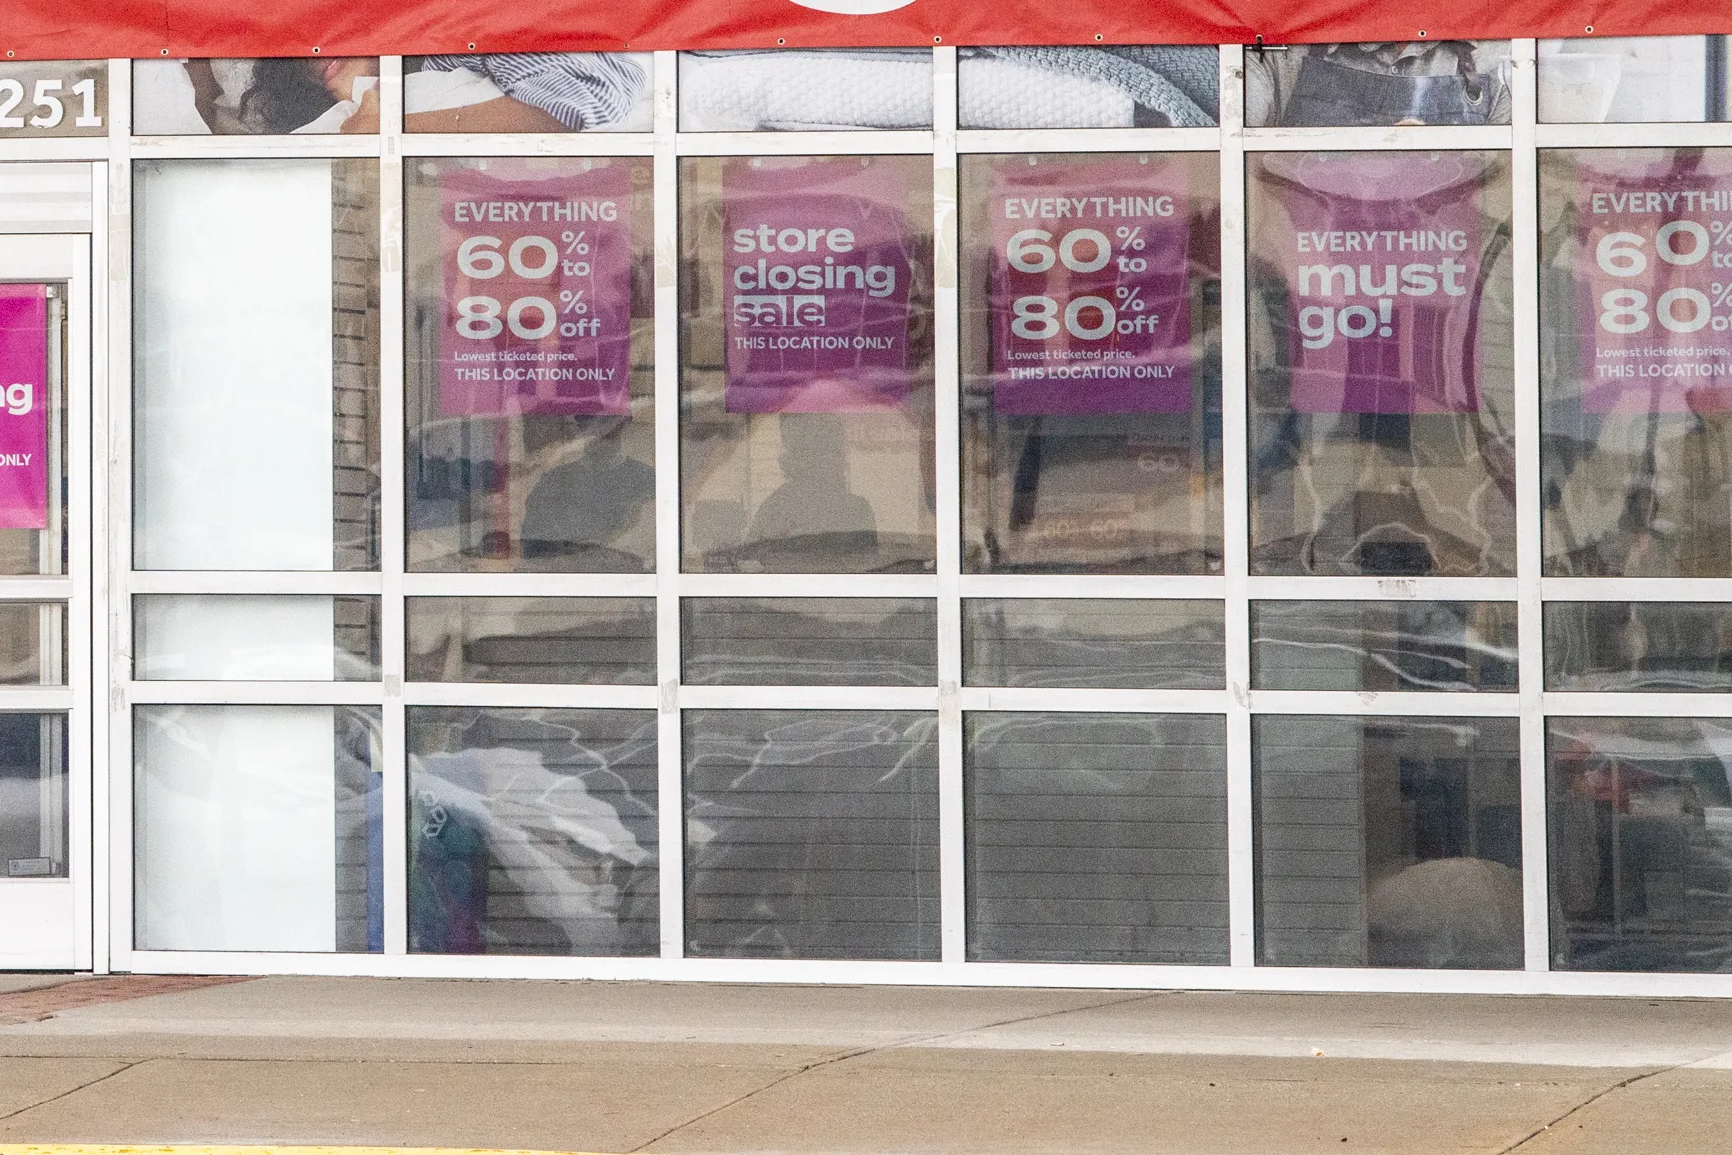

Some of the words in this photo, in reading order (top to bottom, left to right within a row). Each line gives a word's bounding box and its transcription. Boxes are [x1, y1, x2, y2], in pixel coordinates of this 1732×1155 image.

[454, 201, 617, 223] EVERYTHING
[1005, 196, 1175, 219] EVERYTHING
[1592, 191, 1732, 214] EVERYTHI
[733, 224, 855, 253] store
[1297, 230, 1468, 254] EVERYTHING
[562, 258, 590, 278] to
[1117, 255, 1147, 274] to
[733, 257, 896, 298] closing
[1298, 257, 1466, 296] must
[733, 295, 826, 327] sale
[559, 318, 601, 338] off
[1117, 315, 1159, 335] off
[1298, 298, 1393, 350] go!
[735, 336, 767, 350] THIS
[769, 336, 851, 350] LOCATION
[853, 335, 895, 349] ONLY
[1596, 347, 1641, 358] Lowest
[1642, 346, 1693, 357] ticketed
[454, 350, 496, 362] Lowest
[498, 350, 544, 362] ticketed
[546, 351, 578, 364] price.
[1007, 349, 1051, 361] Lowest
[1053, 348, 1102, 360] ticketed
[1103, 348, 1136, 363] price.
[454, 368, 490, 382] THIS
[494, 368, 573, 381] LOCATION
[576, 367, 616, 381] ONLY
[1008, 367, 1045, 380] THIS
[1048, 365, 1133, 379] LOCATION
[1135, 365, 1175, 379] ONLY
[1596, 364, 1635, 378] THIS
[1639, 363, 1726, 377] LOCATION
